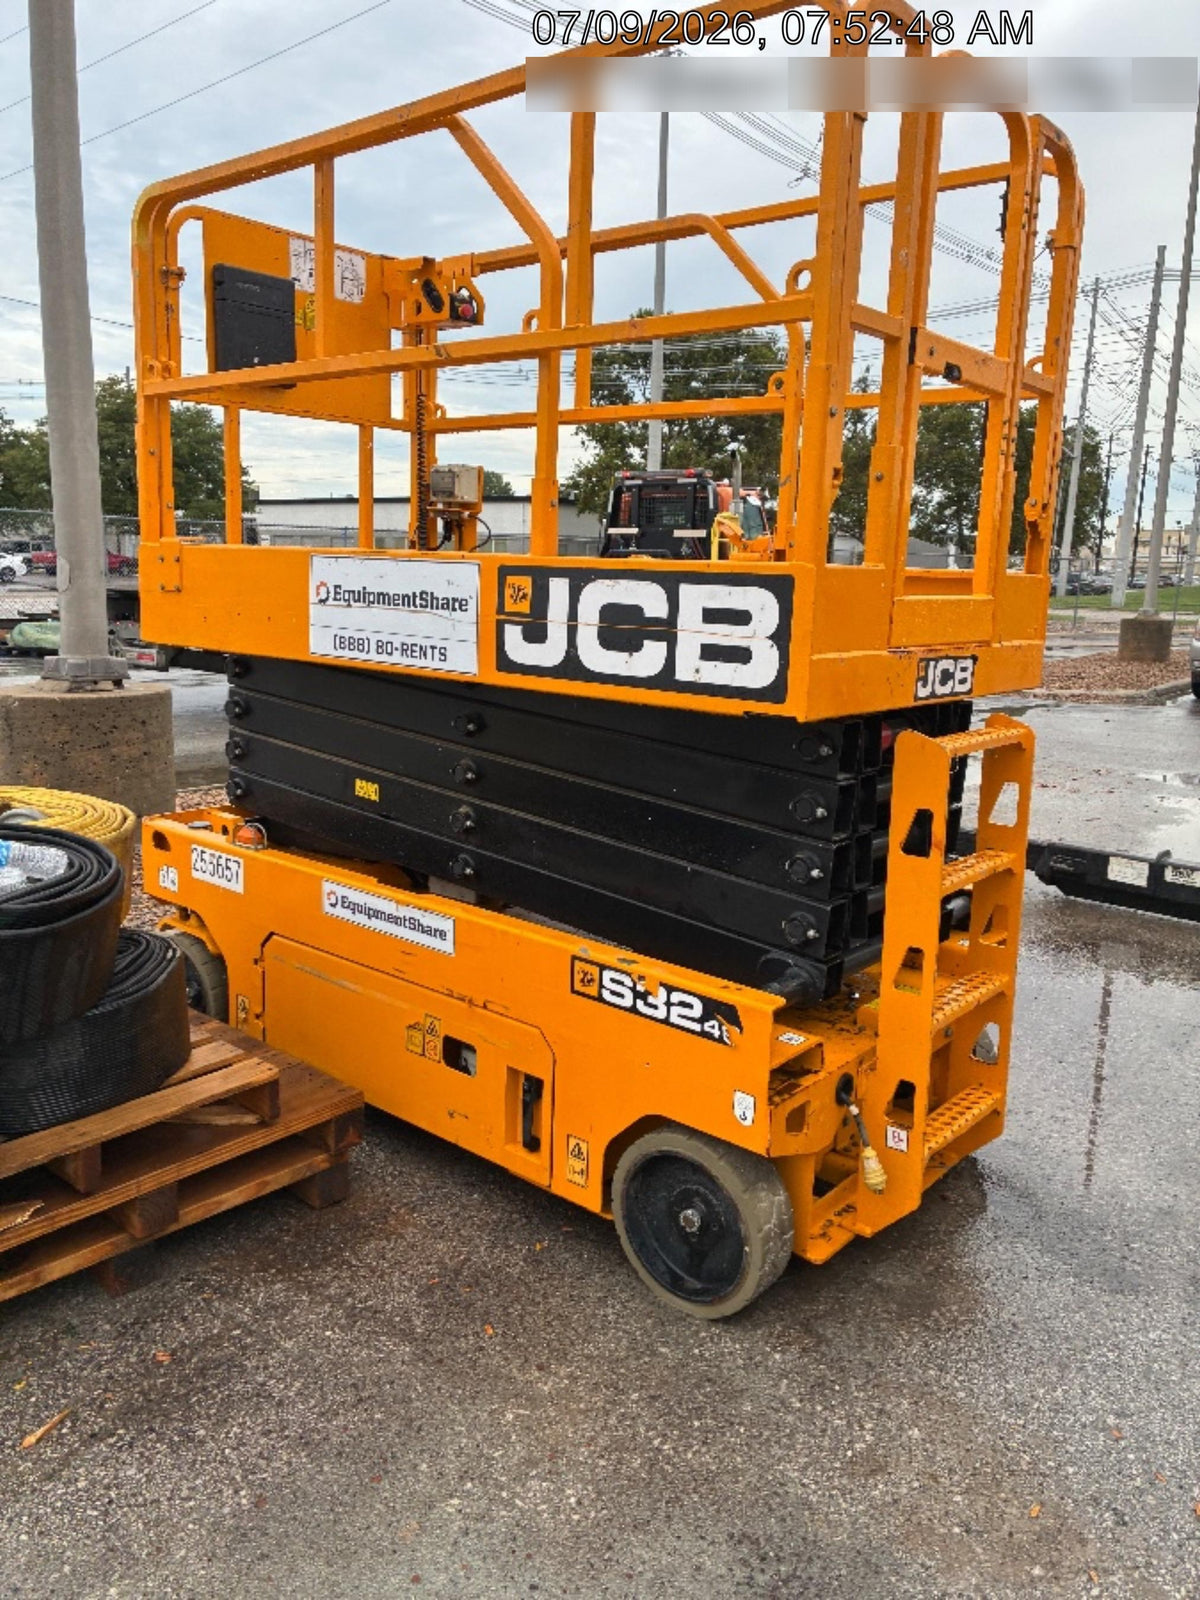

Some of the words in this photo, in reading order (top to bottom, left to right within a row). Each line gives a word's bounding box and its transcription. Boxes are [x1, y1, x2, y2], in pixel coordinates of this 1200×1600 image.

[332, 585, 469, 613] EquipmentShare
[504, 577, 779, 688] JCB
[917, 659, 973, 697] JCB
[341, 895, 447, 941] EquipmentShare
